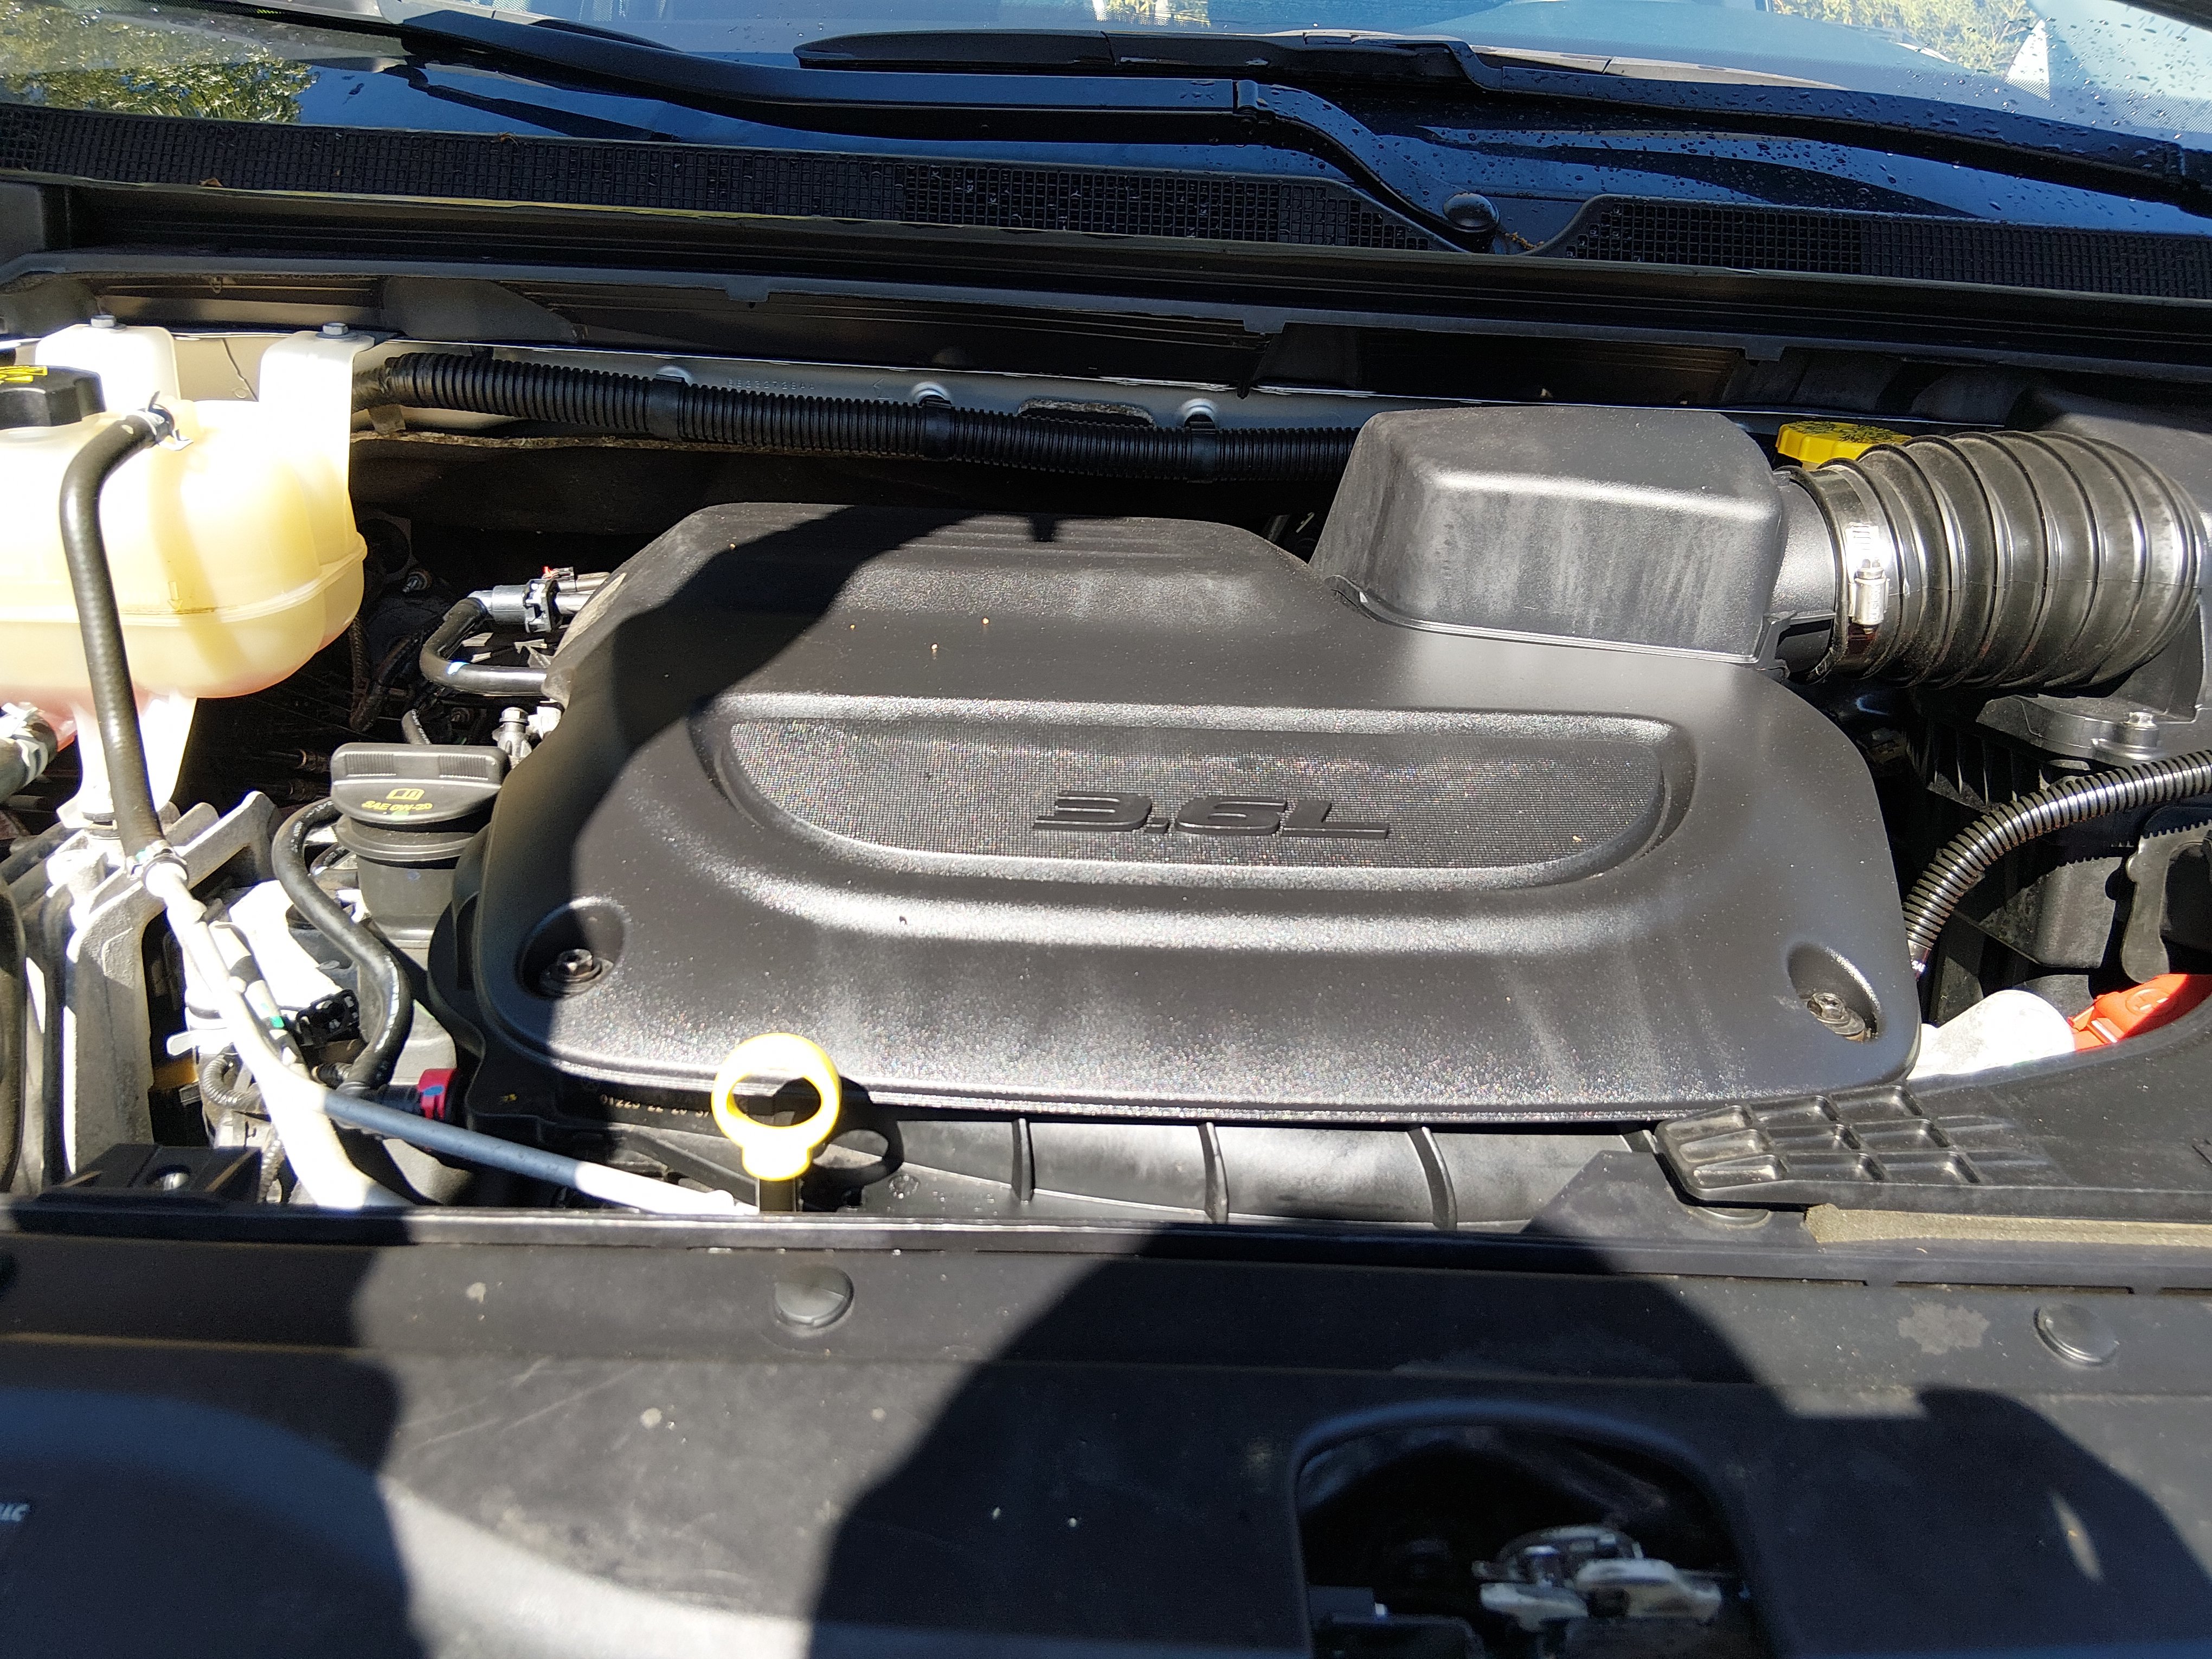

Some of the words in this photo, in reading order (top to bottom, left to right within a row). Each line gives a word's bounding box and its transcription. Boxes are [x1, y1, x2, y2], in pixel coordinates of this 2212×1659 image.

[362, 800, 391, 811] SAE
[389, 803, 433, 812] 0W-20
[1031, 791, 1389, 839] 3.6L
